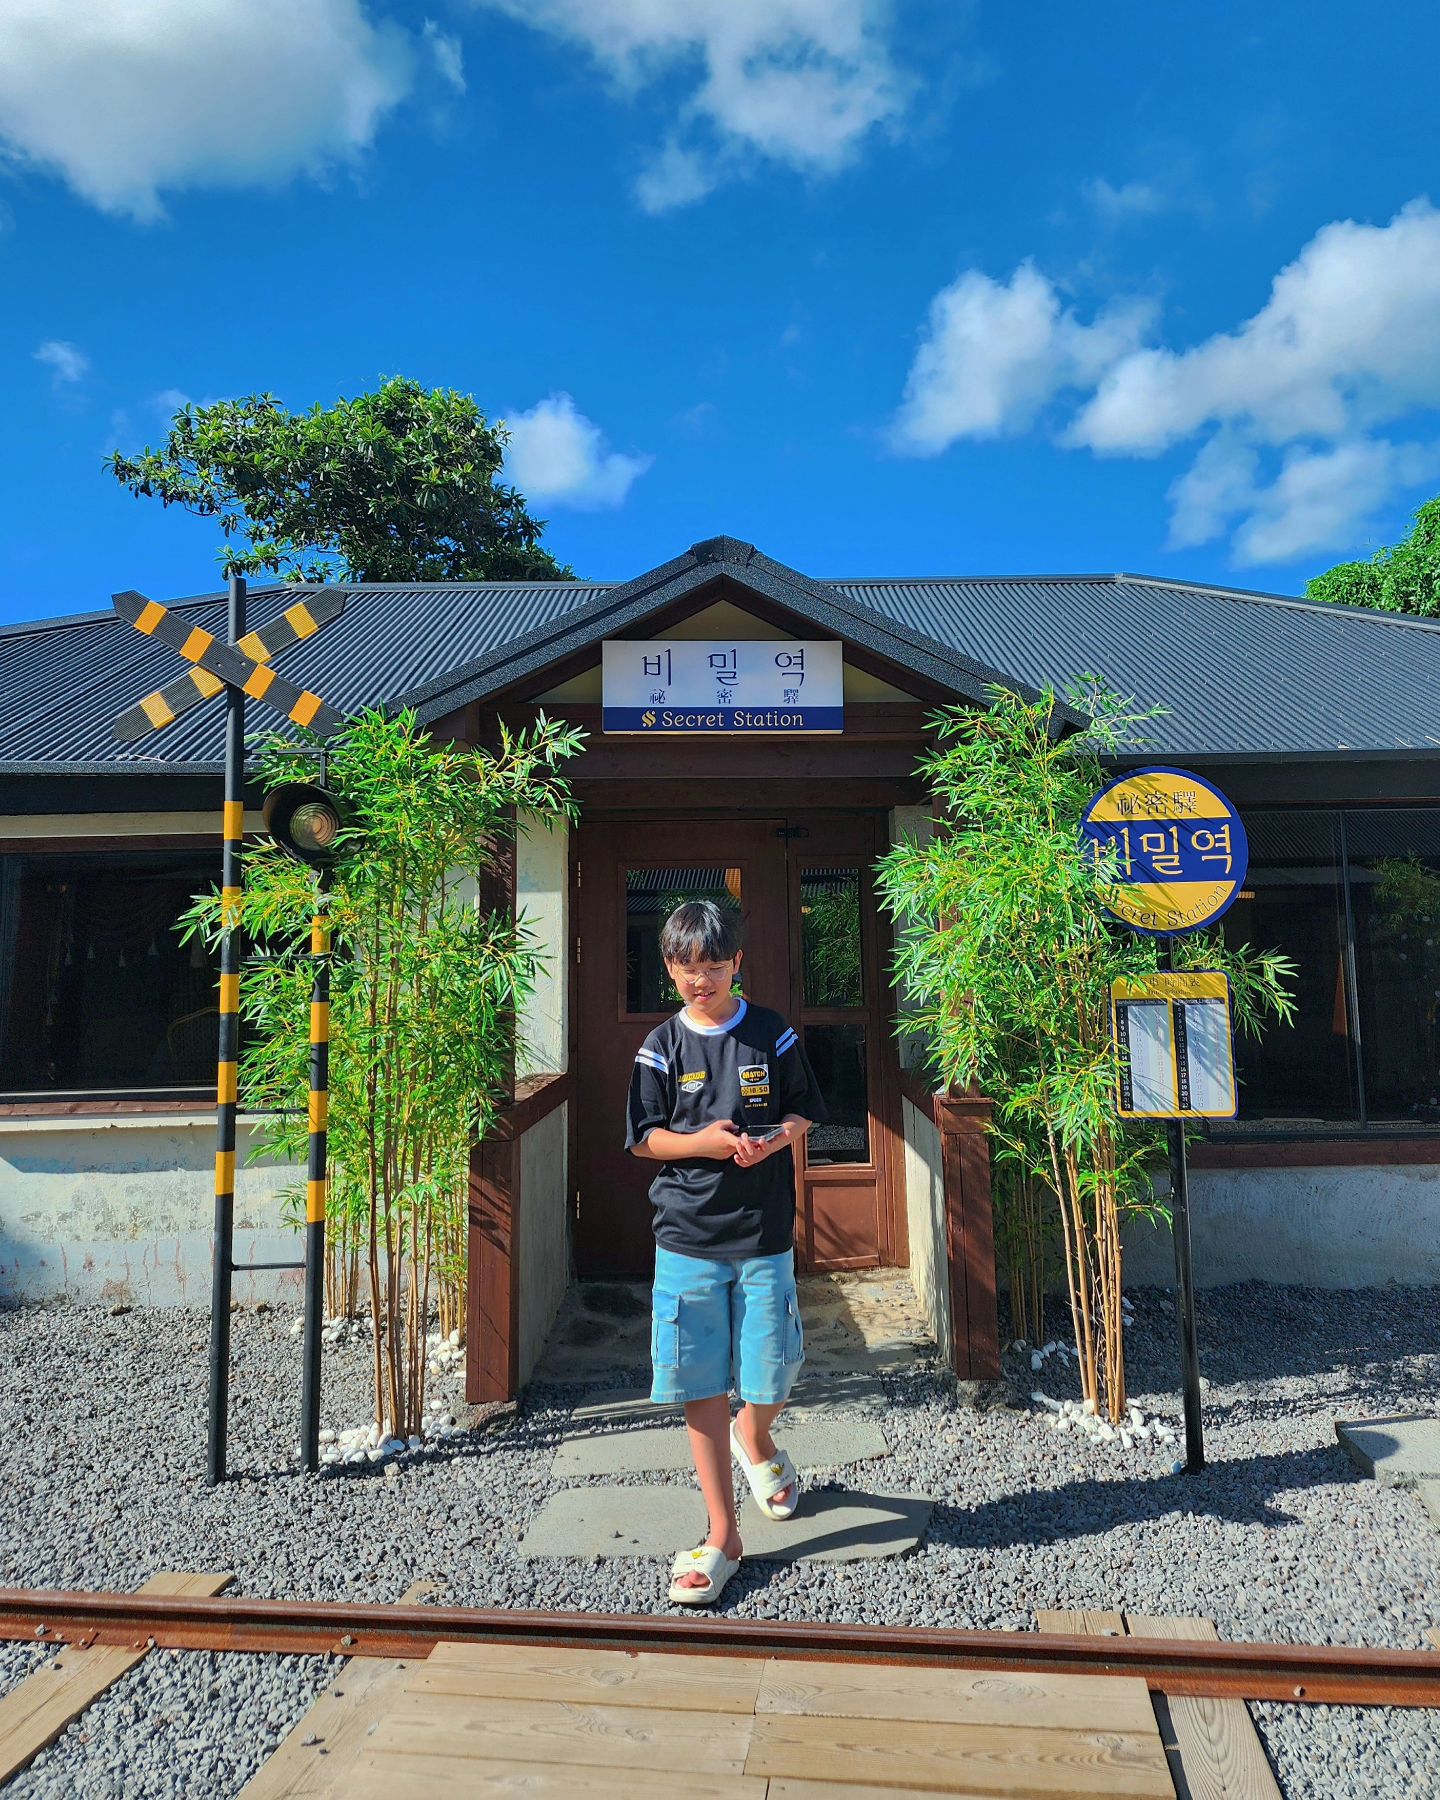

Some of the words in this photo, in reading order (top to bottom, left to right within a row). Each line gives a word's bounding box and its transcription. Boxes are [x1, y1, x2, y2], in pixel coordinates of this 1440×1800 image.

[662, 710, 725, 727] Secret
[733, 710, 804, 727] Station
[1167, 884, 1228, 927] Station
